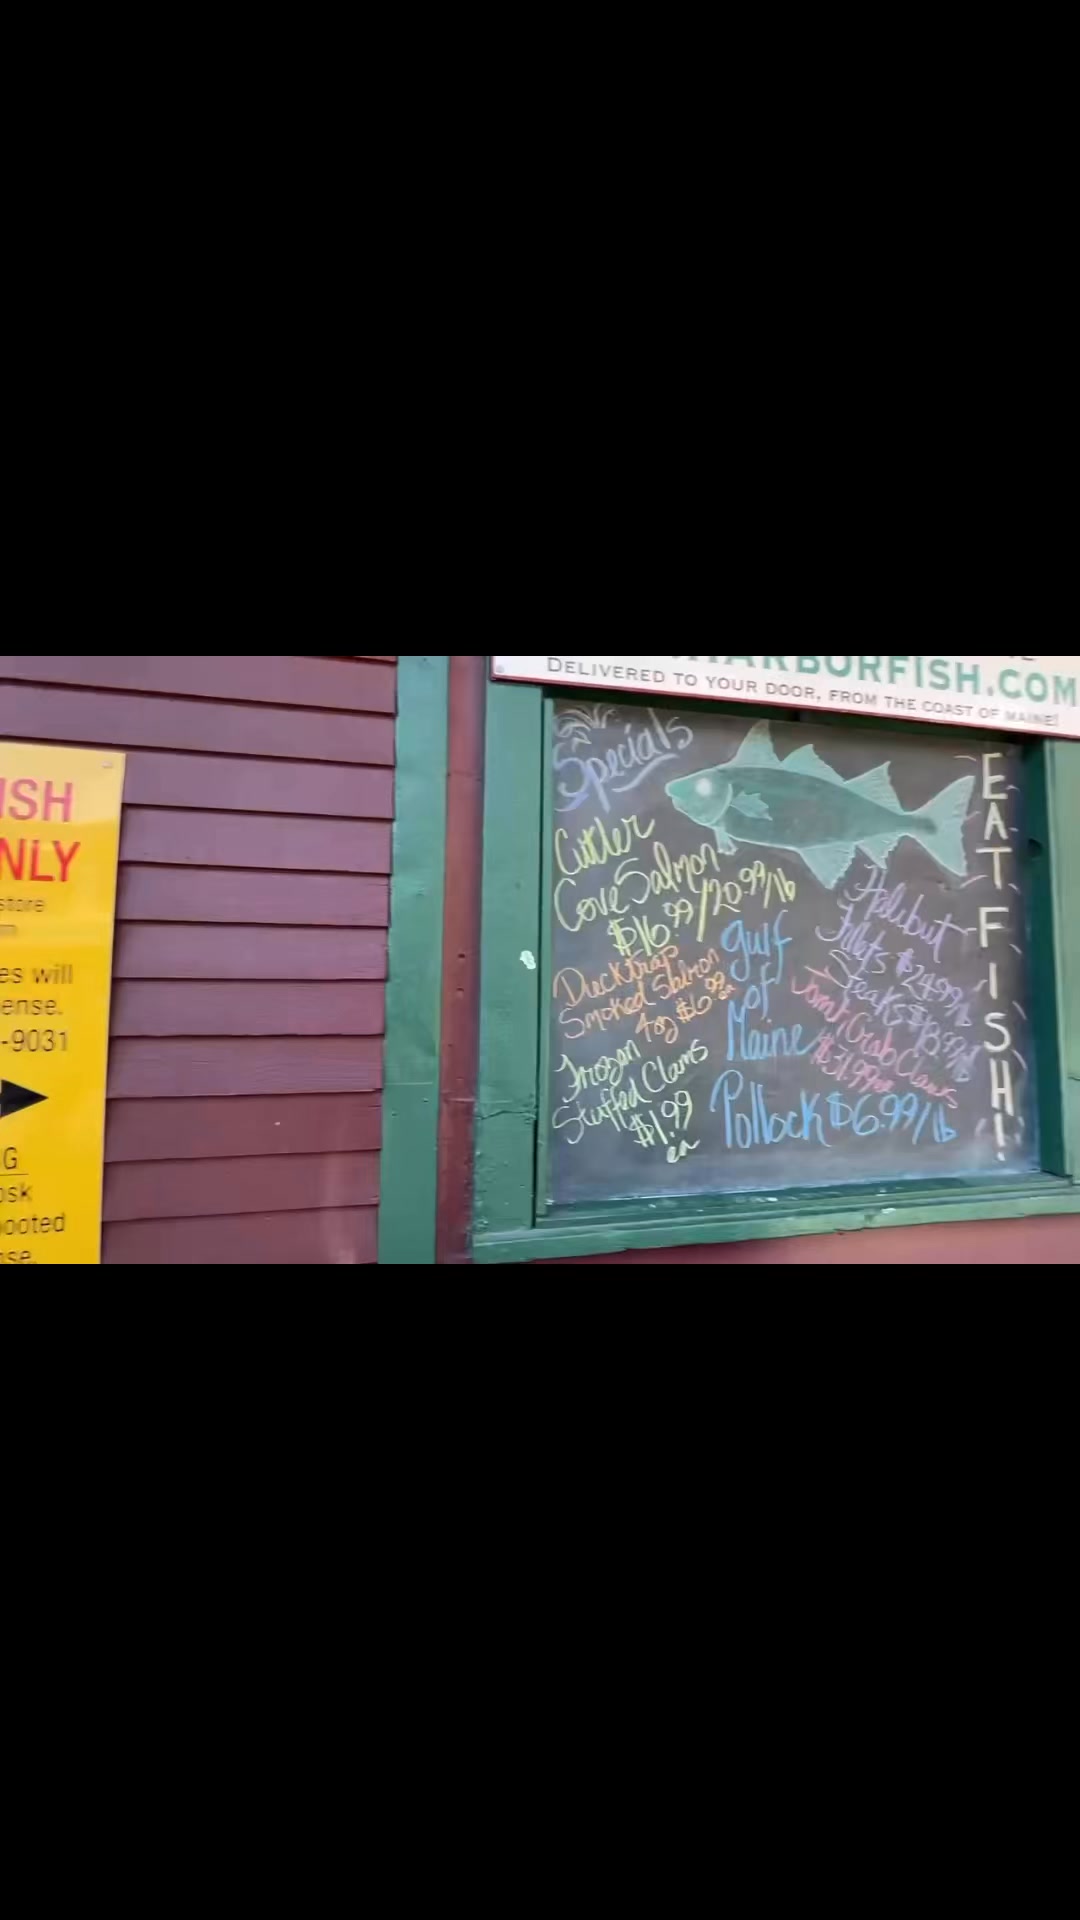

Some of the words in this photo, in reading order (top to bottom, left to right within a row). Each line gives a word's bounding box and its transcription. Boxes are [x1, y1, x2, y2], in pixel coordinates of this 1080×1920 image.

[547, 657, 665, 683] DELIVERED
[673, 672, 697, 687] TO
[705, 676, 758, 694] YOUR
[765, 682, 821, 701] DOOR,
[829, 689, 877, 705] FROM
[884, 696, 917, 711] THE
[922, 701, 974, 717] COAST
[978, 707, 999, 719] OF
[1005, 711, 1059, 727] MAINE!
[553, 706, 693, 813] Specials
[555, 815, 655, 875] Cutler
[976, 752, 1012, 890] EAT
[554, 878, 631, 932] Cove
[614, 841, 720, 904] Salmon
[843, 863, 972, 963] Halibut
[32, 964, 73, 984] will
[744, 962, 777, 1021] of
[559, 981, 656, 1039] Smoked
[726, 1000, 822, 1061] Maine
[845, 1011, 898, 1066] Crab
[978, 906, 1014, 1162] FISH!
[642, 1039, 709, 1093] Clams
[709, 1068, 832, 1149] Pollock
